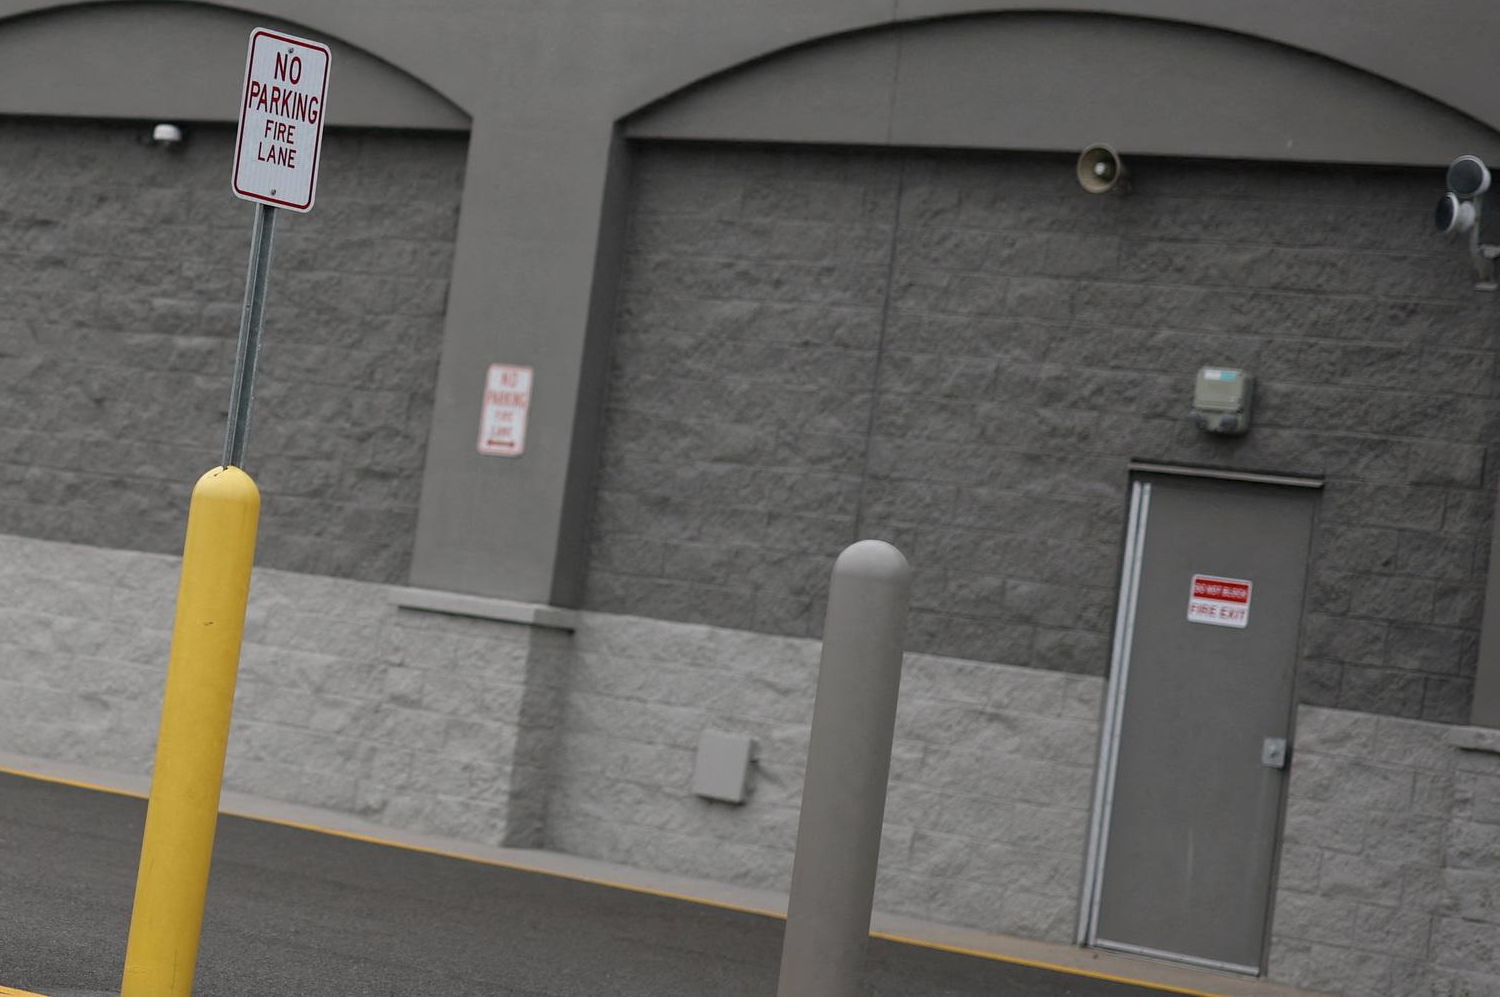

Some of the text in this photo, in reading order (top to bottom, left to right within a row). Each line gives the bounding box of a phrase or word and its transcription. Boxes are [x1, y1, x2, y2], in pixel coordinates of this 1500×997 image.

[274, 51, 302, 85] NO
[248, 80, 319, 125] PARKING
[264, 119, 296, 145] FIRE
[257, 142, 297, 169] LANE
[1190, 603, 1246, 620] FIRE EXIT
